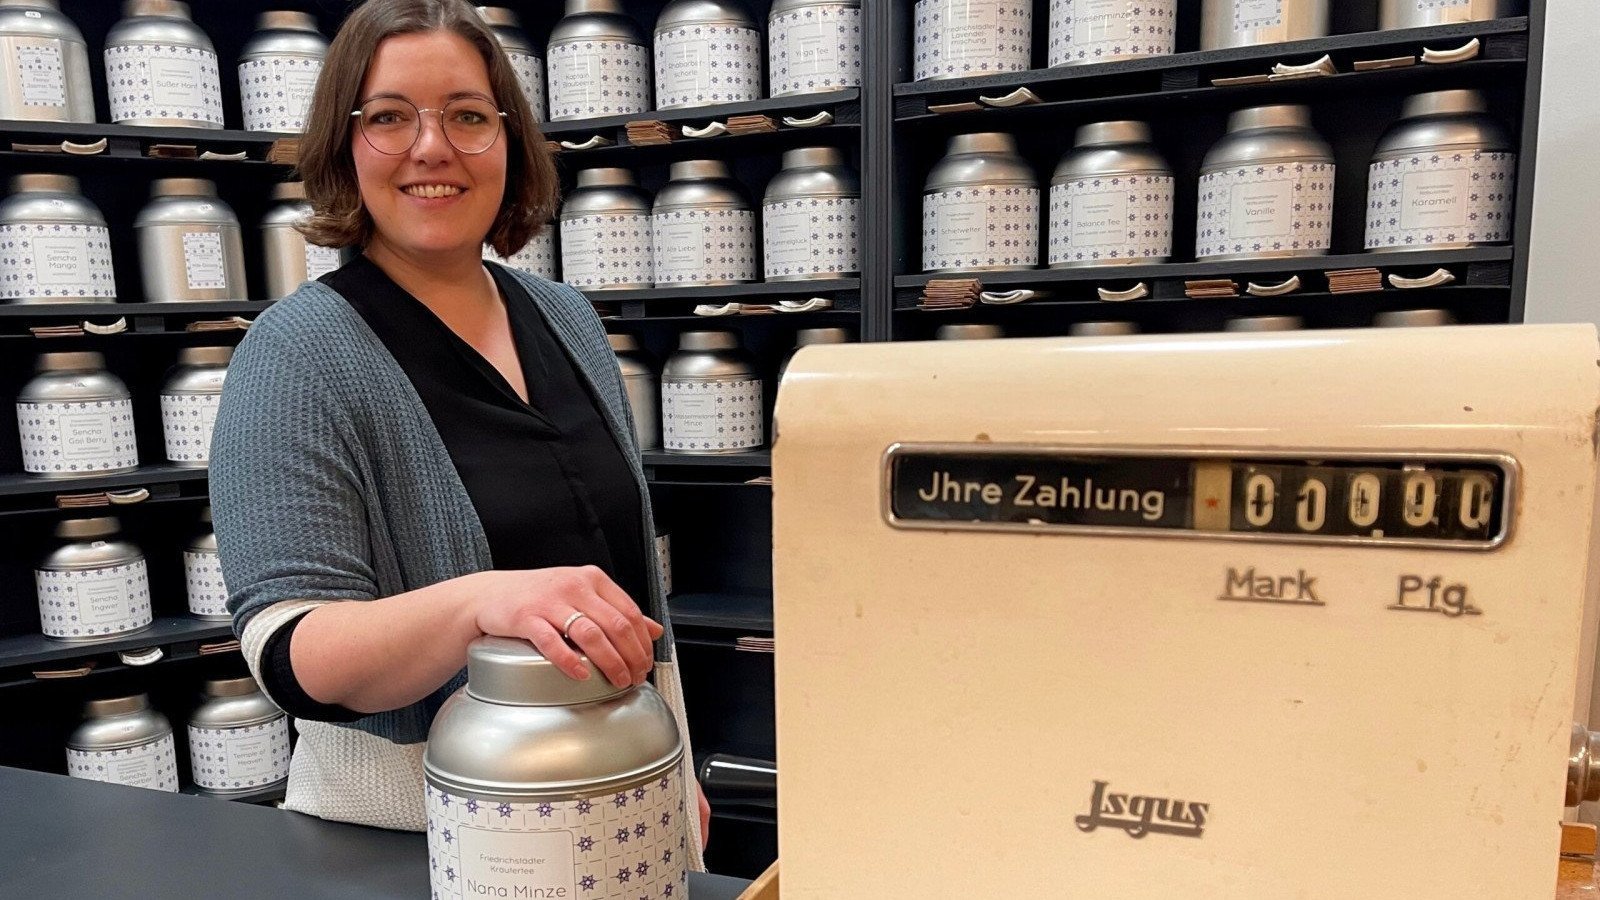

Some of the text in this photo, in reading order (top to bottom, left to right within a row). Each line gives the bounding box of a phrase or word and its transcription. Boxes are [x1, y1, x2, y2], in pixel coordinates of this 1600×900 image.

[1411, 196, 1457, 207] Karamell
[1245, 206, 1276, 216] Vanille
[1076, 218, 1121, 228] Balance Tee
[48, 261, 77, 270] Mango
[72, 428, 102, 436] Sencha
[1013, 474, 1165, 520] Zahlung
[1224, 566, 1319, 600] Mark
[90, 595, 118, 603] Sencha
[467, 878, 567, 898] Nana Minze
